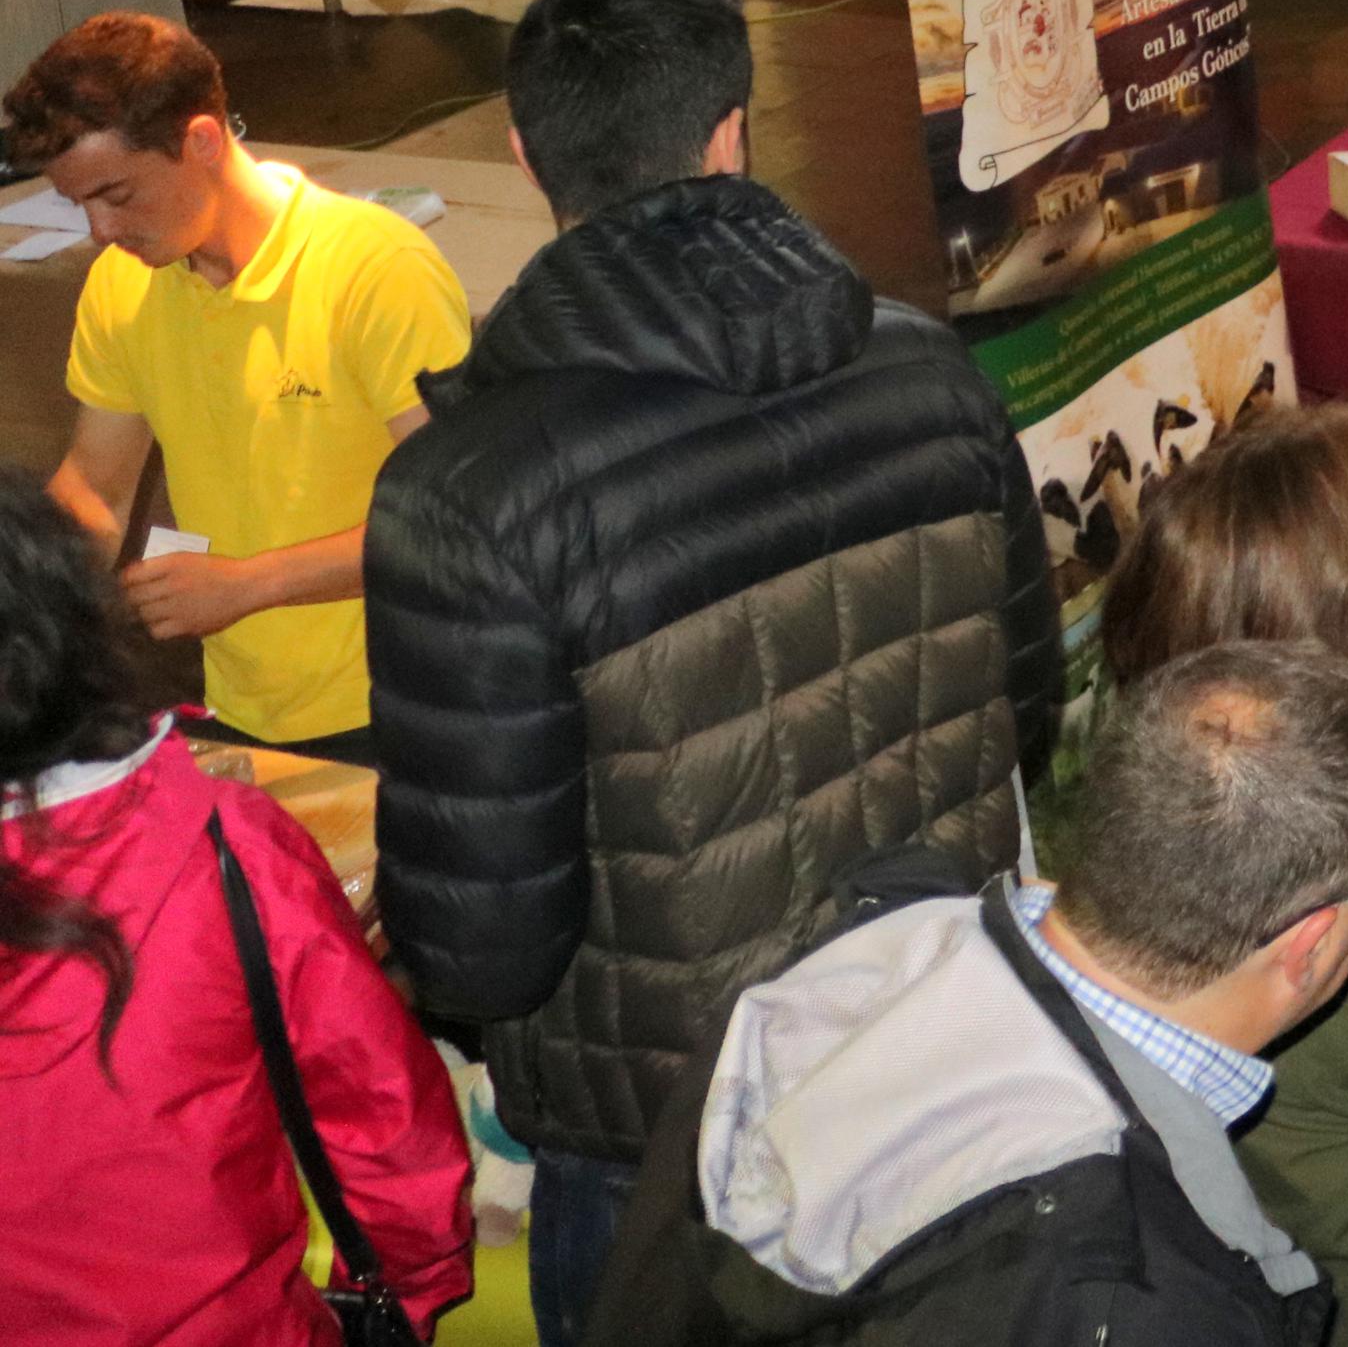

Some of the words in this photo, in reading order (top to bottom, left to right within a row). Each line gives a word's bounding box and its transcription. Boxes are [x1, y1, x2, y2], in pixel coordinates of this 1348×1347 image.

[1142, 35, 1166, 60] en
[1167, 22, 1187, 50] la
[1192, 0, 1239, 38] Tierra
[1125, 65, 1200, 112] Campos
